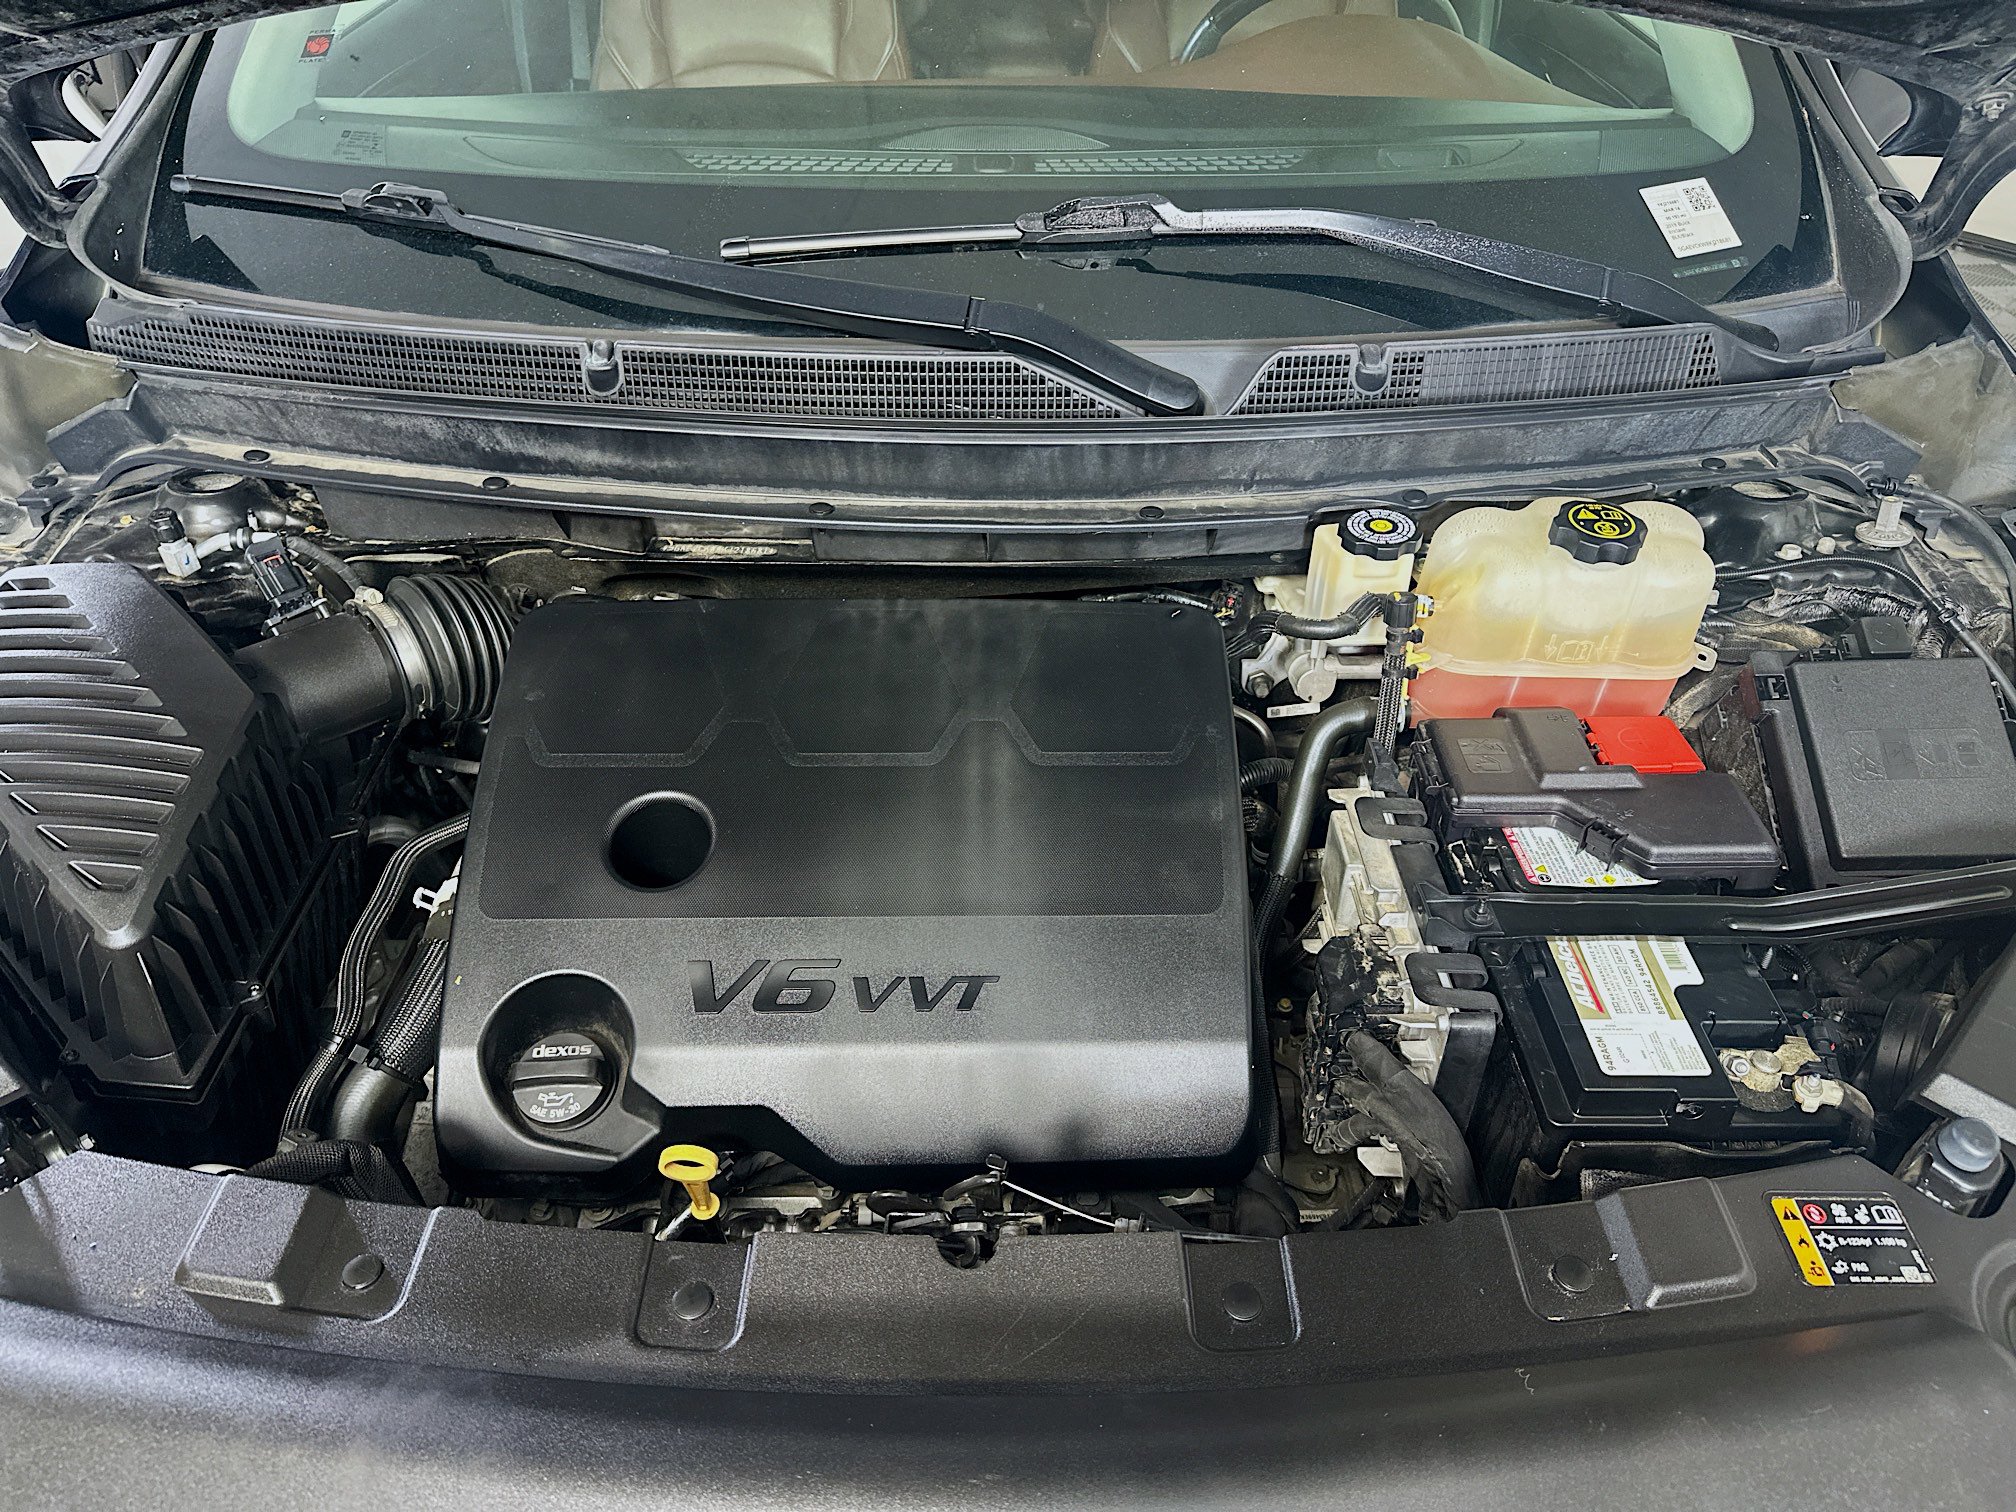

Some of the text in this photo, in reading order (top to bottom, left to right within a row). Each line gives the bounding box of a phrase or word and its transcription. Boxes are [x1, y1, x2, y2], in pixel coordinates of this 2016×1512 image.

[1626, 948, 1648, 976] 94RAGM
[688, 958, 1000, 1014] V6 VVT
[1641, 979, 1666, 1014] 88864542
[532, 1044, 594, 1058] dexos
[1595, 1036, 1616, 1071] 94RAGM
[530, 1102, 581, 1118] SAE 5W-30
[1850, 1261, 1870, 1273] PAG
